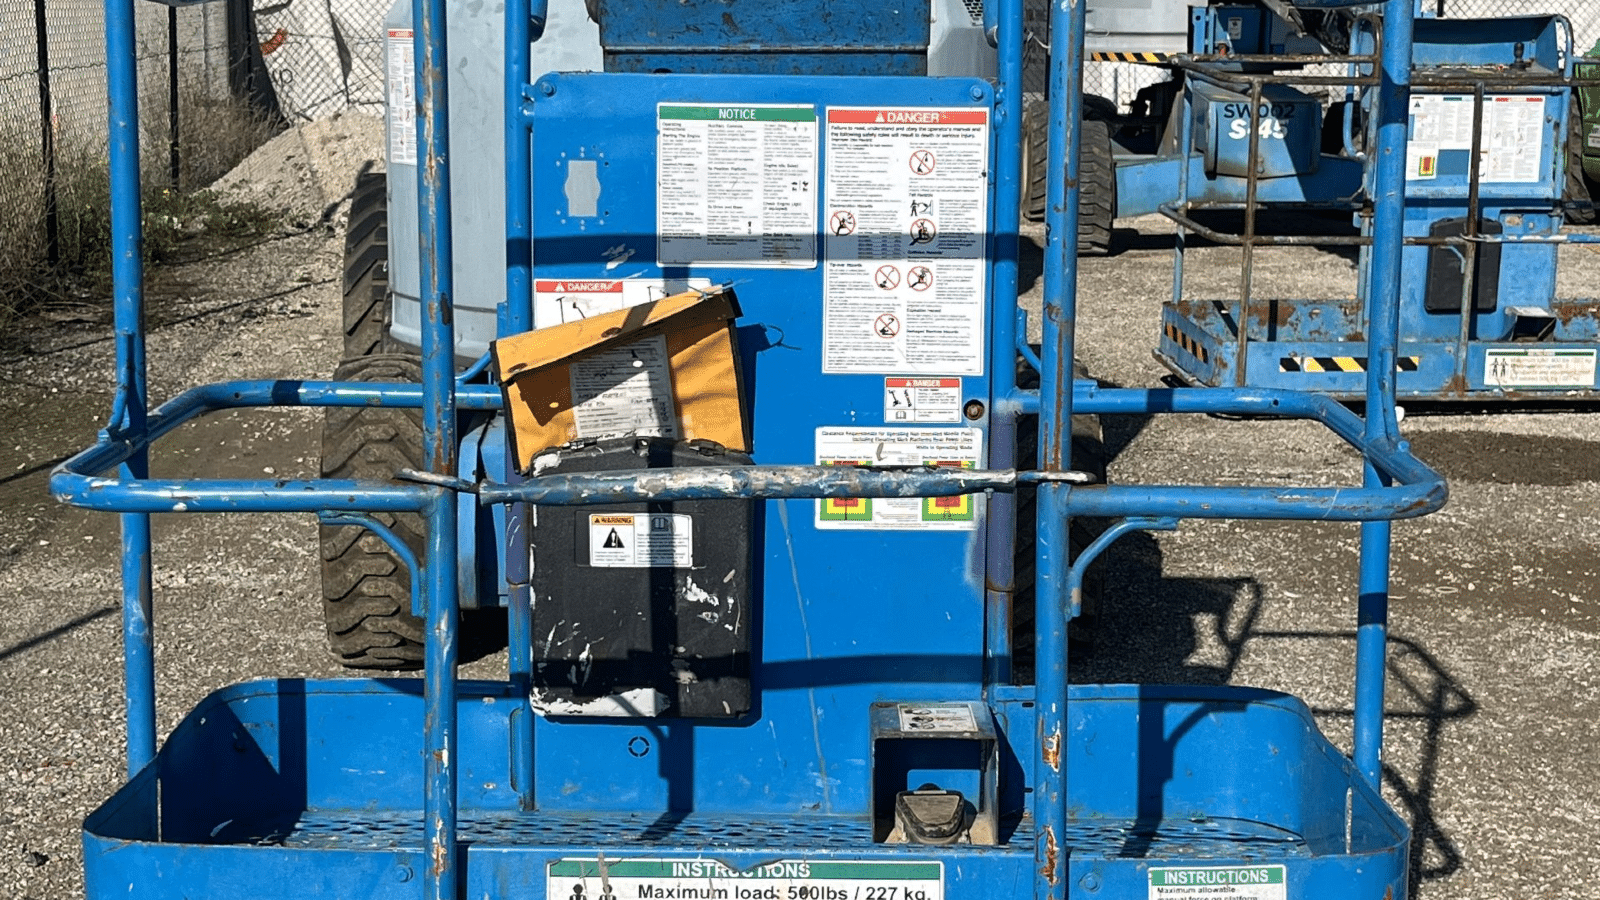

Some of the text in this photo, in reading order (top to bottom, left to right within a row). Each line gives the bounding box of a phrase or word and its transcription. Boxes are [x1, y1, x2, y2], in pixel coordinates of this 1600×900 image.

[718, 108, 756, 120] NOTICE
[887, 112, 940, 122] DANGER
[1164, 869, 1269, 884] INSTRUCTIONS
[639, 884, 728, 898] Maximum
[736, 886, 780, 899] load:
[788, 886, 848, 899] 500lbs
[854, 887, 860, 899] /
[866, 887, 898, 899] 227
